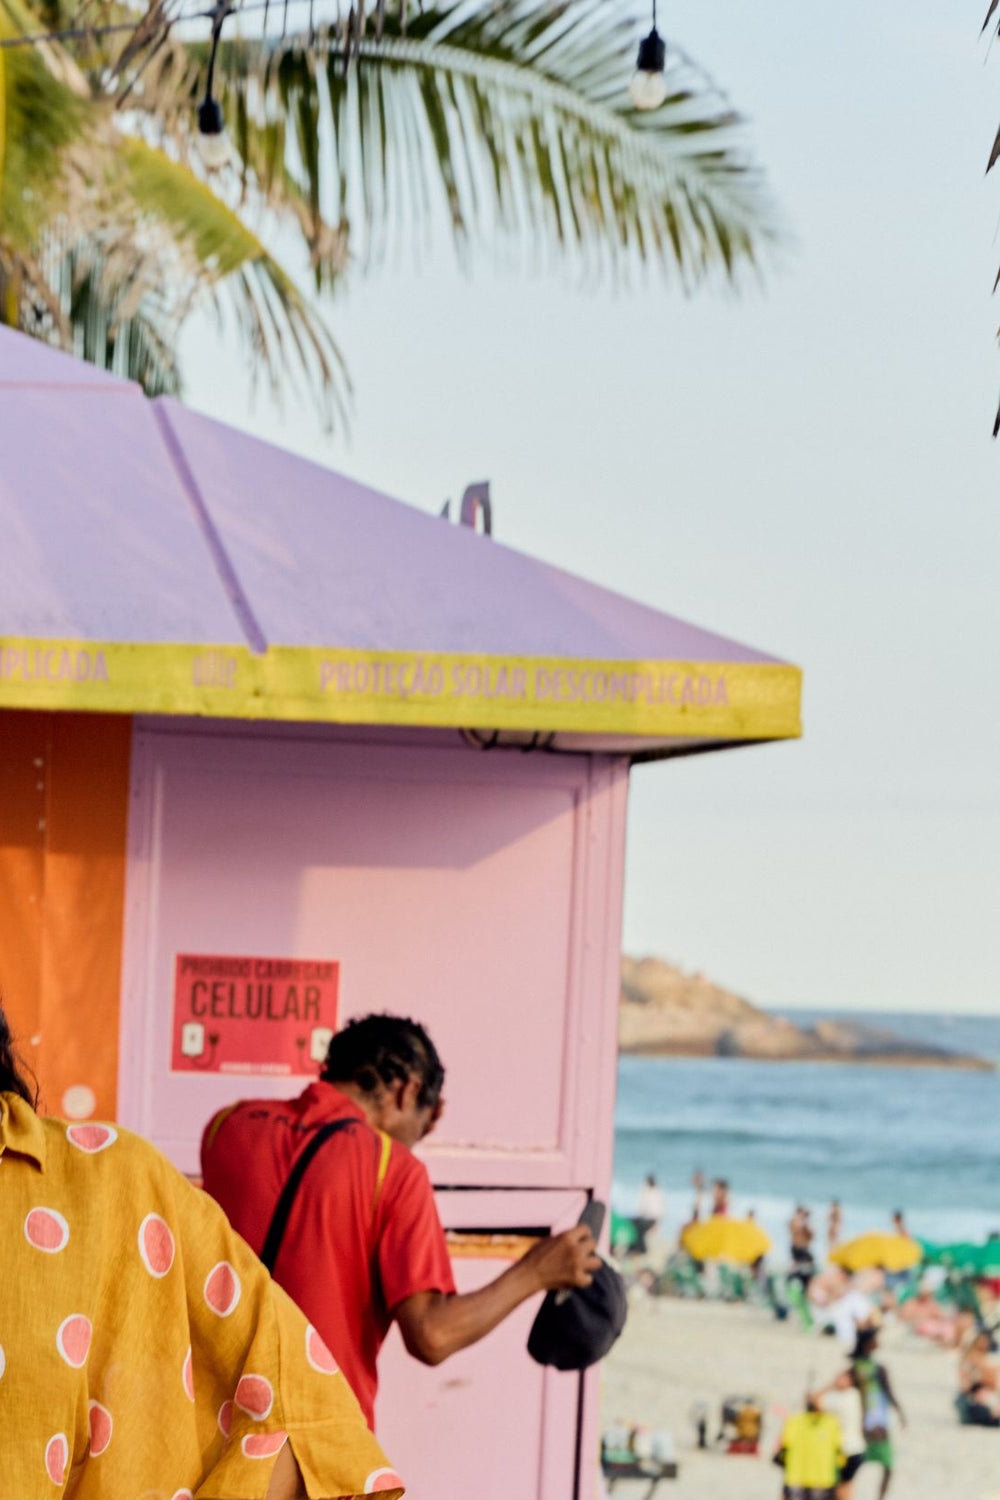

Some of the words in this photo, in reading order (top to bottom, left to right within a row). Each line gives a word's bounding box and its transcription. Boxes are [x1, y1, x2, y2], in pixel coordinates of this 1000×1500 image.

[320, 656, 445, 701] PROTEÇÃO
[451, 663, 527, 700] SOLAR
[535, 668, 730, 706] DESCOMPLICADA
[190, 980, 321, 1021] CELULAR
